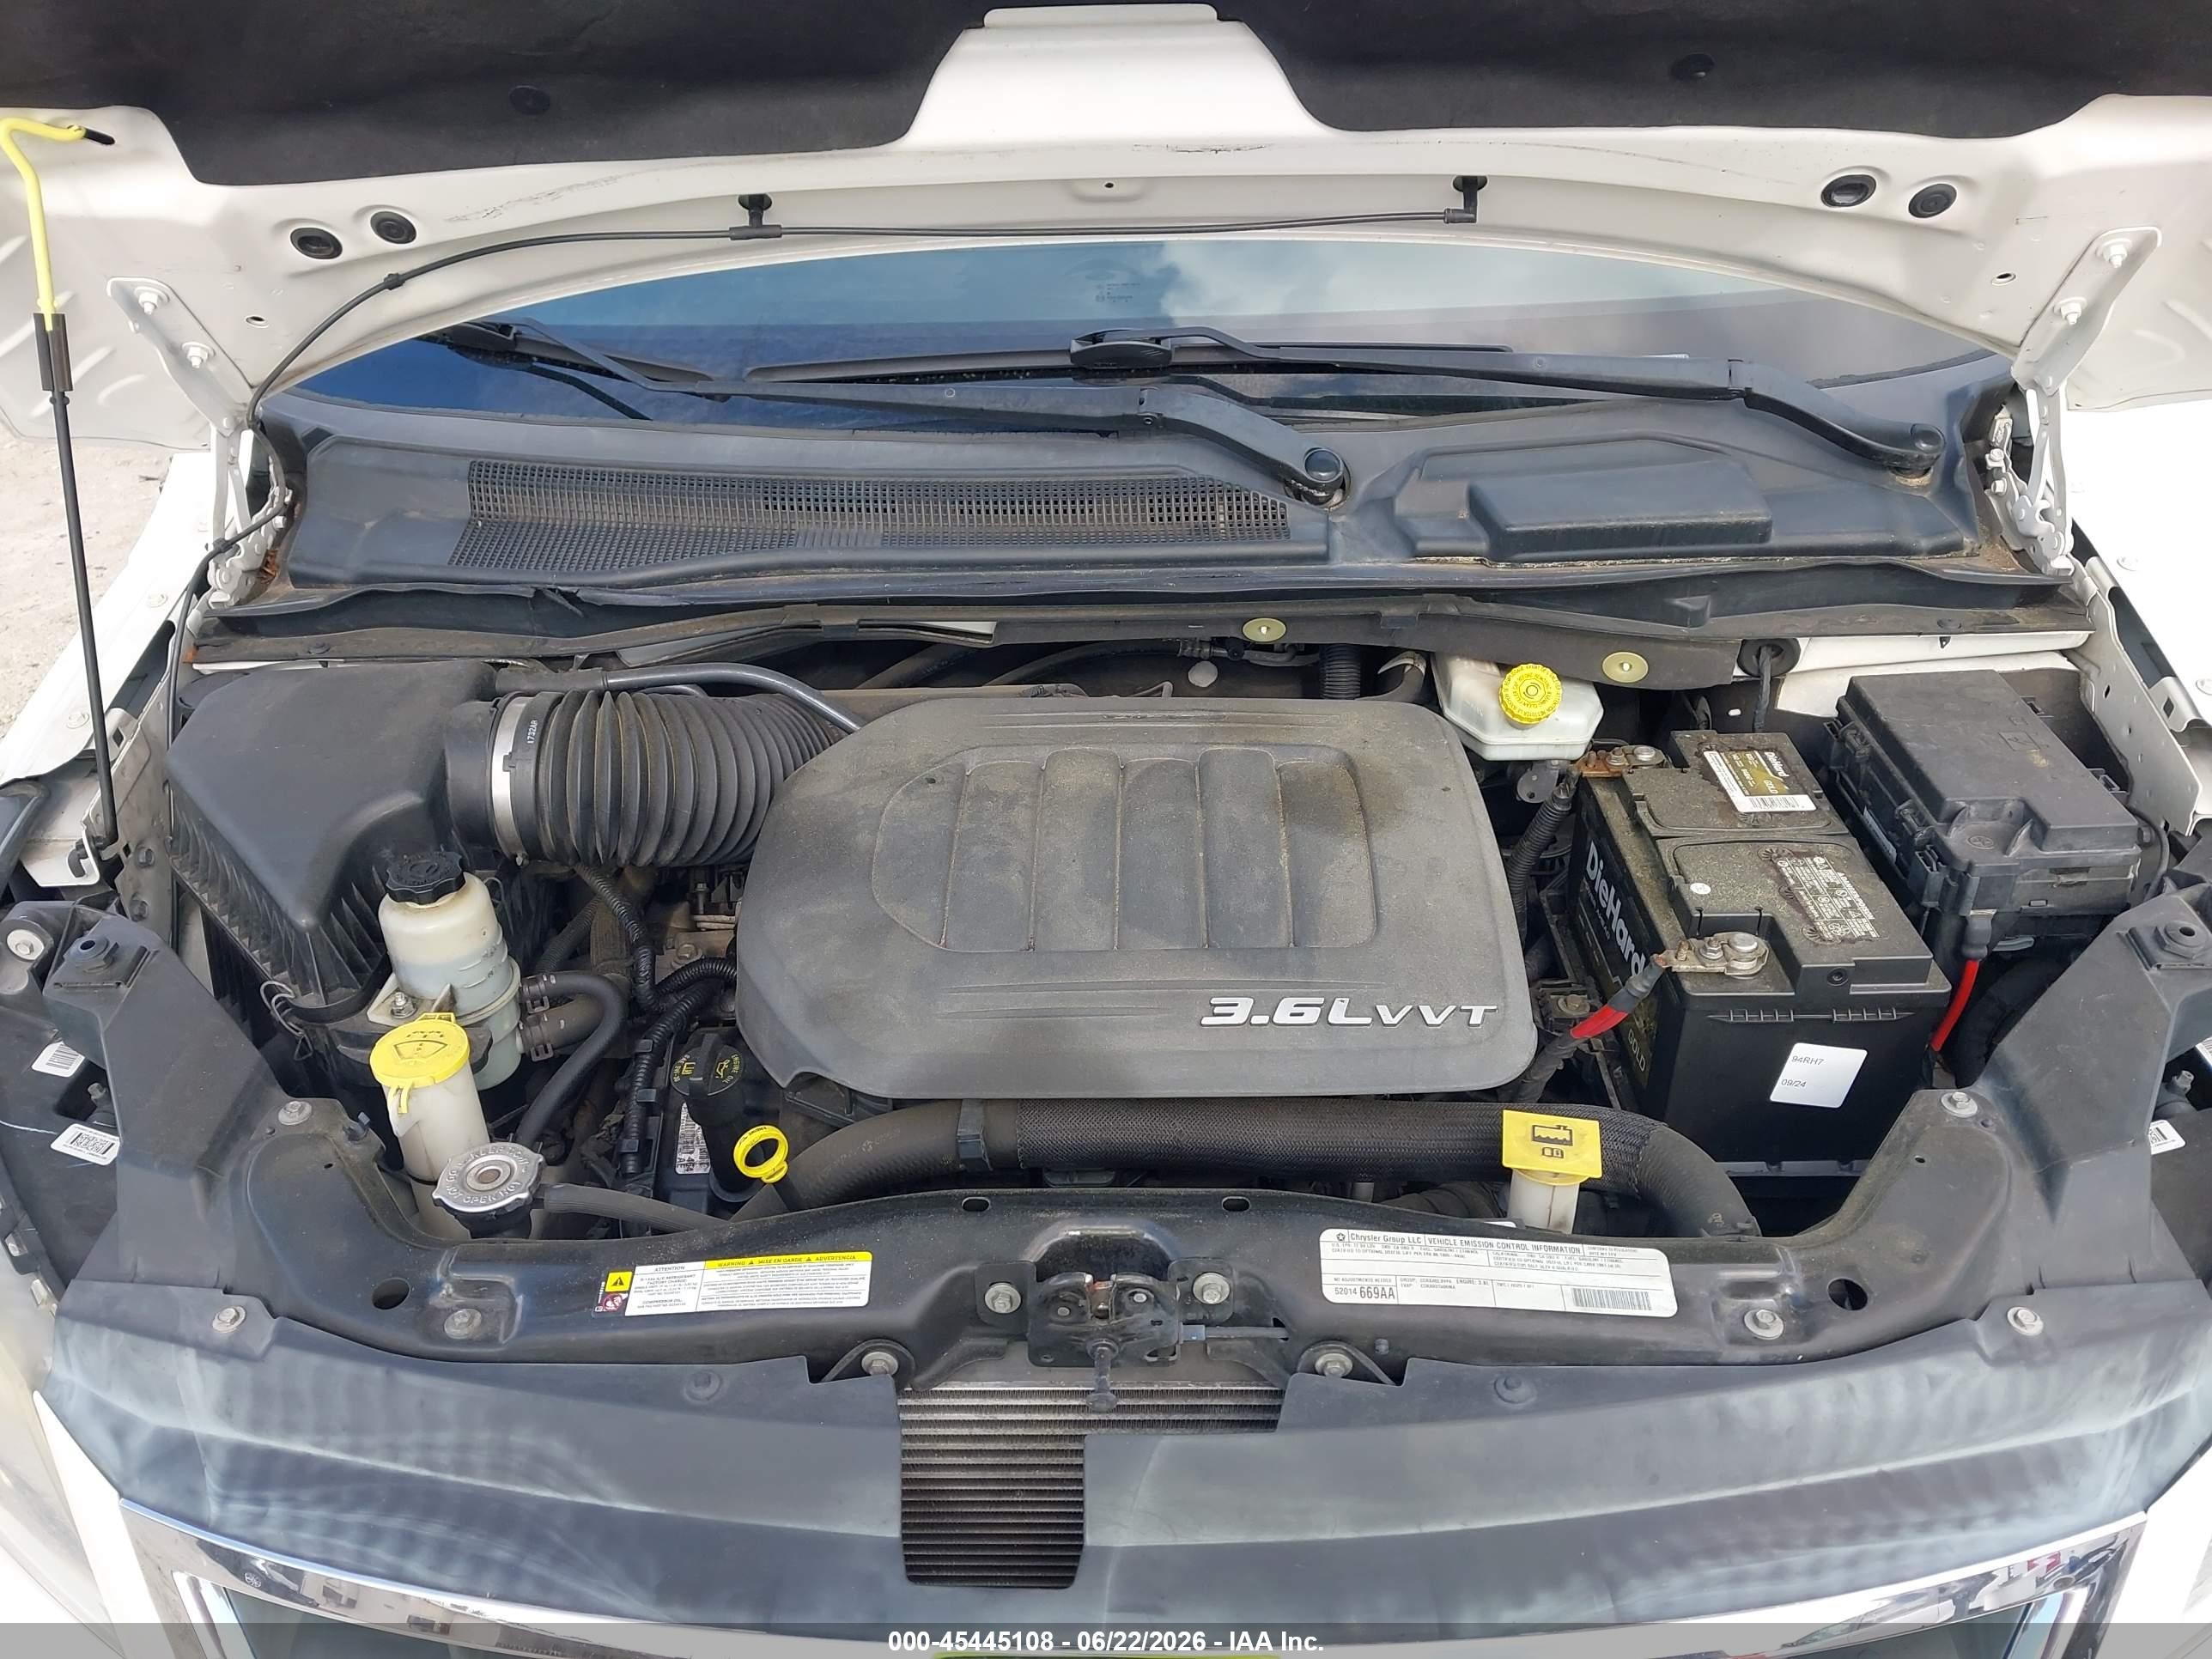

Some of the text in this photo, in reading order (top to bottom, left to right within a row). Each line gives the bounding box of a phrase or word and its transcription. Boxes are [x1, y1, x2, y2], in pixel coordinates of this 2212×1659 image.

[1764, 751, 1790, 777] DieHard
[1764, 780, 1778, 794] GOLD
[1586, 840, 1646, 977] DieHard
[1628, 1030, 1646, 1072] GOLD
[722, 1075, 734, 1084] OIL
[1781, 1079, 1808, 1088] 09/24
[1351, 1232, 1381, 1243] Chrysler
[1383, 1235, 1406, 1244] Group
[1428, 1237, 1457, 1247] VEHICLE
[1460, 1239, 1494, 1249] EMISSION
[1497, 1242, 1529, 1252] CONTROL
[1532, 1244, 1581, 1255] INFORMATION
[1334, 1286, 1395, 1299] 52014 669AA
